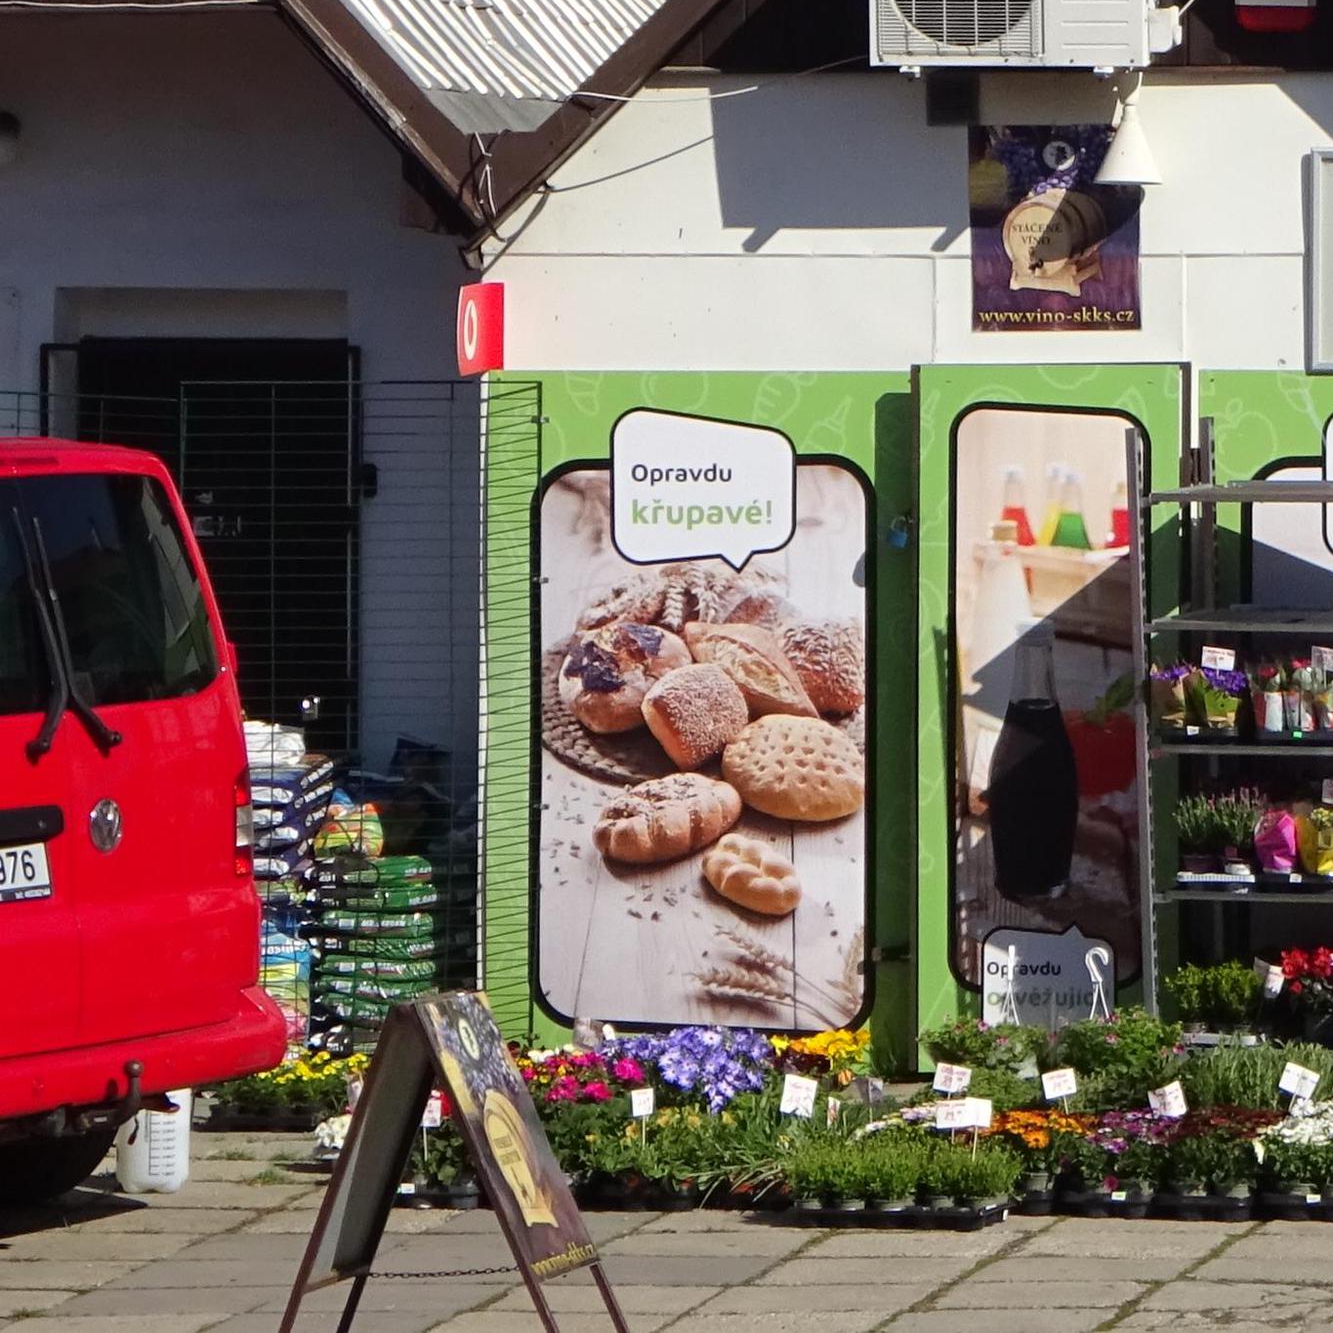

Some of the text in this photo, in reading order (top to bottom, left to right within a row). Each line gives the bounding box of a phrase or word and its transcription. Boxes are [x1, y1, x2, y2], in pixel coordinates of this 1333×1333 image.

[978, 306, 1135, 323] www.vino-skks.cz
[631, 463, 732, 486] Opravdu
[632, 499, 772, 531] křupavé!
